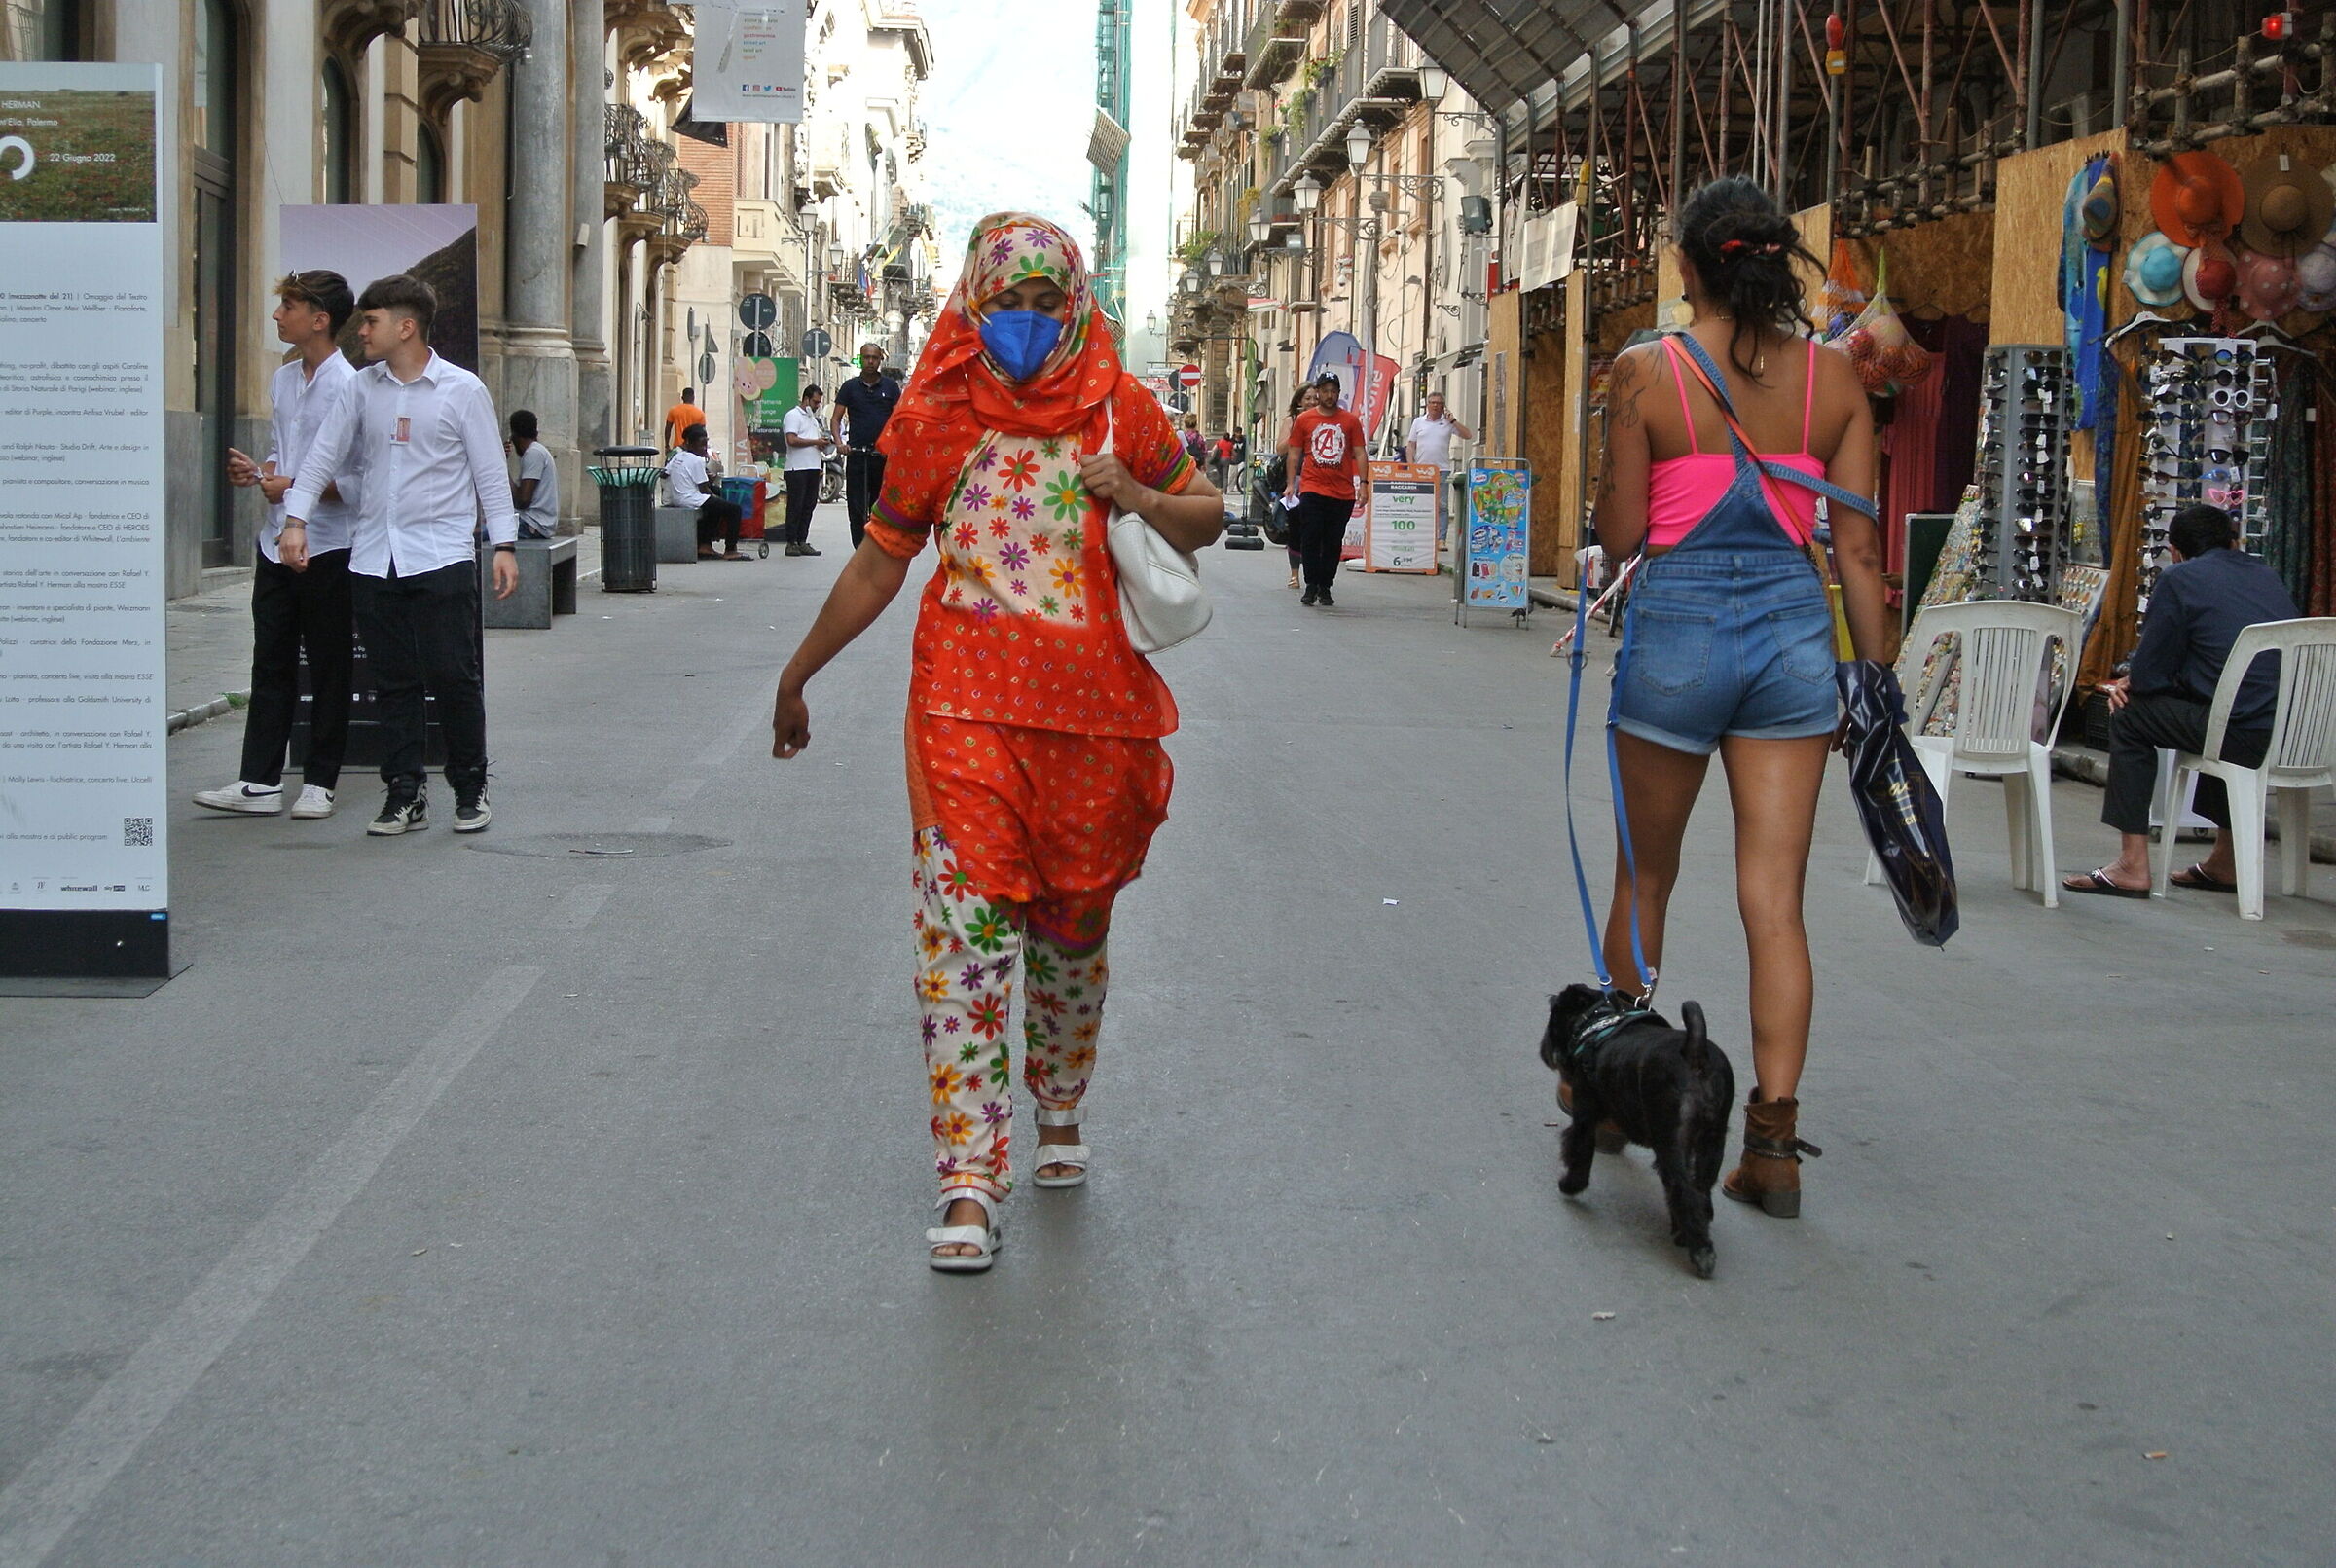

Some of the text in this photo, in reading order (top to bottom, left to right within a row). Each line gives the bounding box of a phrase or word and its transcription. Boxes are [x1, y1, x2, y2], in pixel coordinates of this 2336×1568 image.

[27, 117, 58, 126] Palermo
[62, 154, 91, 164] Giugno
[93, 153, 116, 162] 2022
[83, 293, 114, 302] Omaggio
[91, 362, 100, 371] gli
[67, 384, 87, 393] Parigi
[120, 443, 141, 452] design
[41, 454, 66, 462] inglese)
[1393, 495, 1414, 504] very
[1392, 521, 1415, 530] 100
[41, 615, 65, 624] inglese)
[112, 695, 142, 704] University
[57, 832, 79, 841] public
